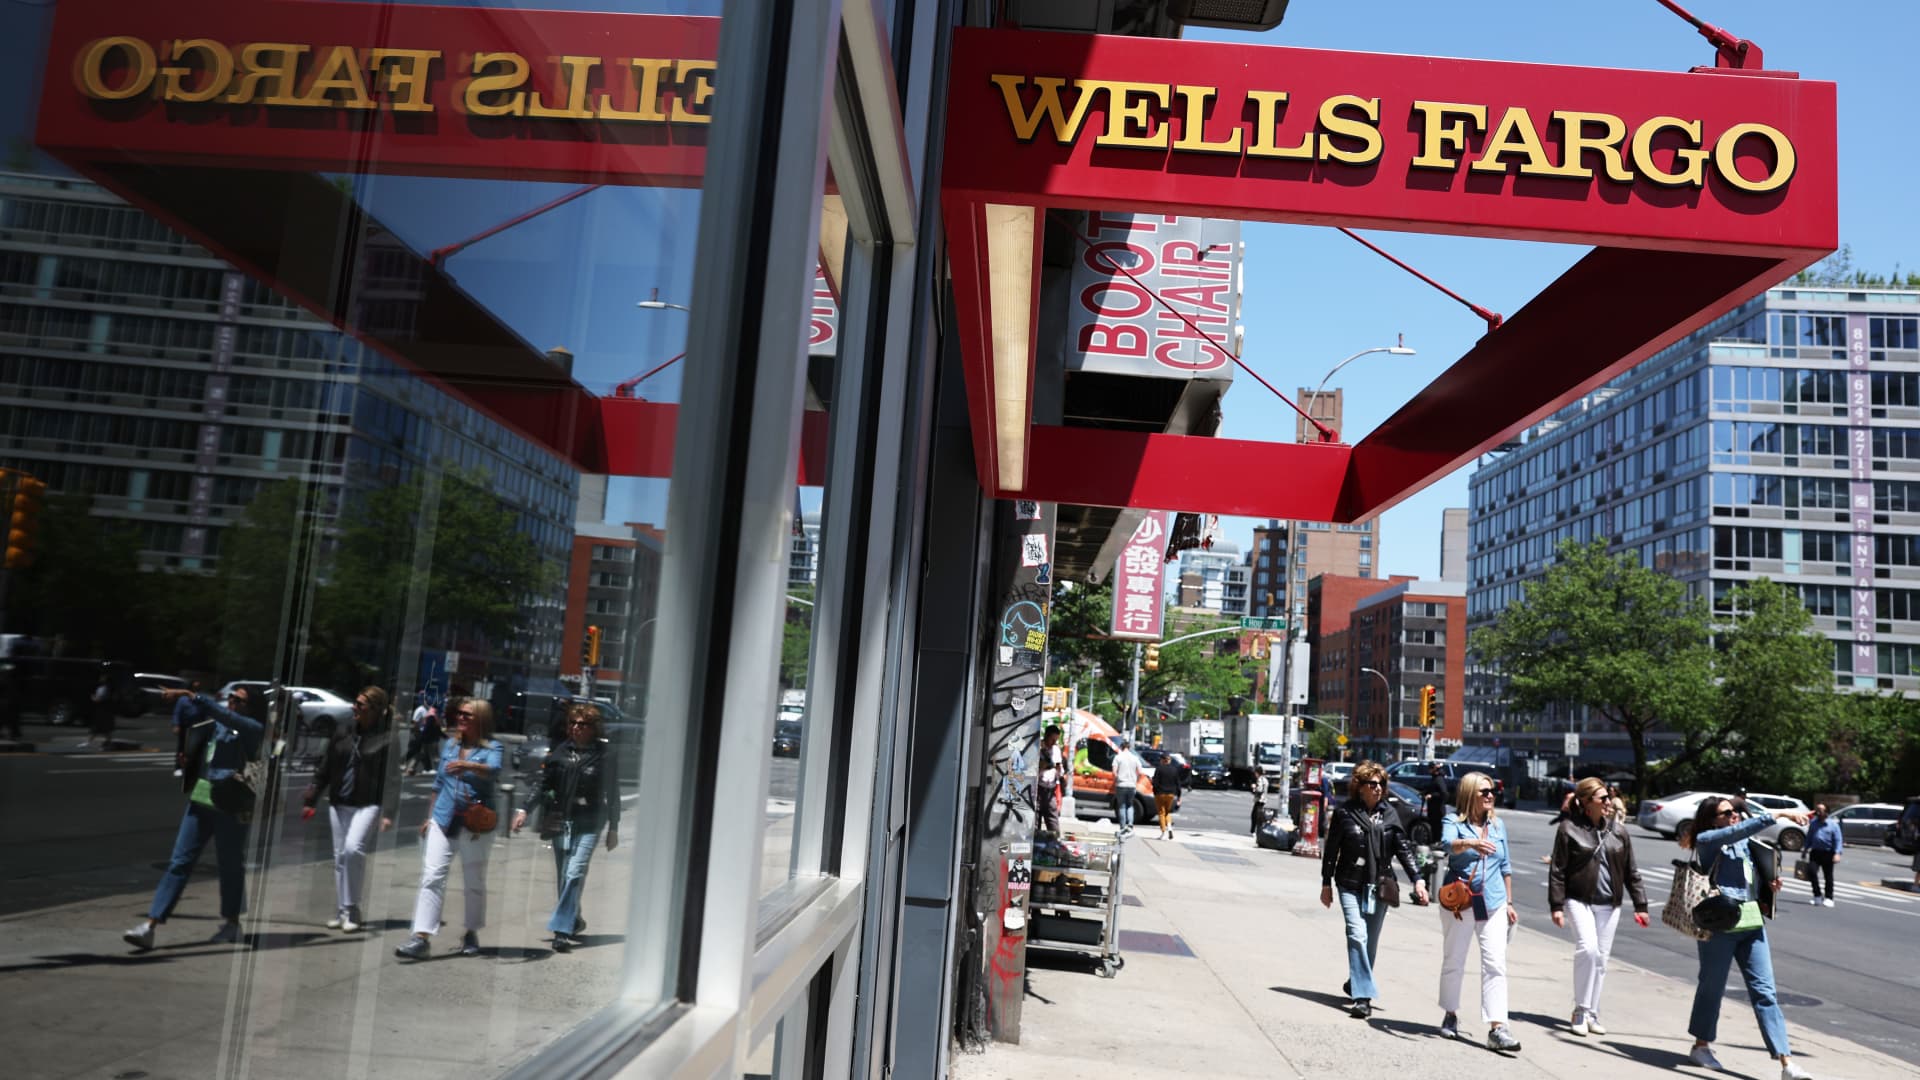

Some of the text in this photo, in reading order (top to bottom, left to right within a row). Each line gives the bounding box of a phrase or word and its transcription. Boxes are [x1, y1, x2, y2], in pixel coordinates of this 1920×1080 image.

[991, 74, 1797, 192] WELLS FARGO
[1123, 510, 1163, 631] 沙發專賣行
[1857, 578, 1870, 657] AVALON
